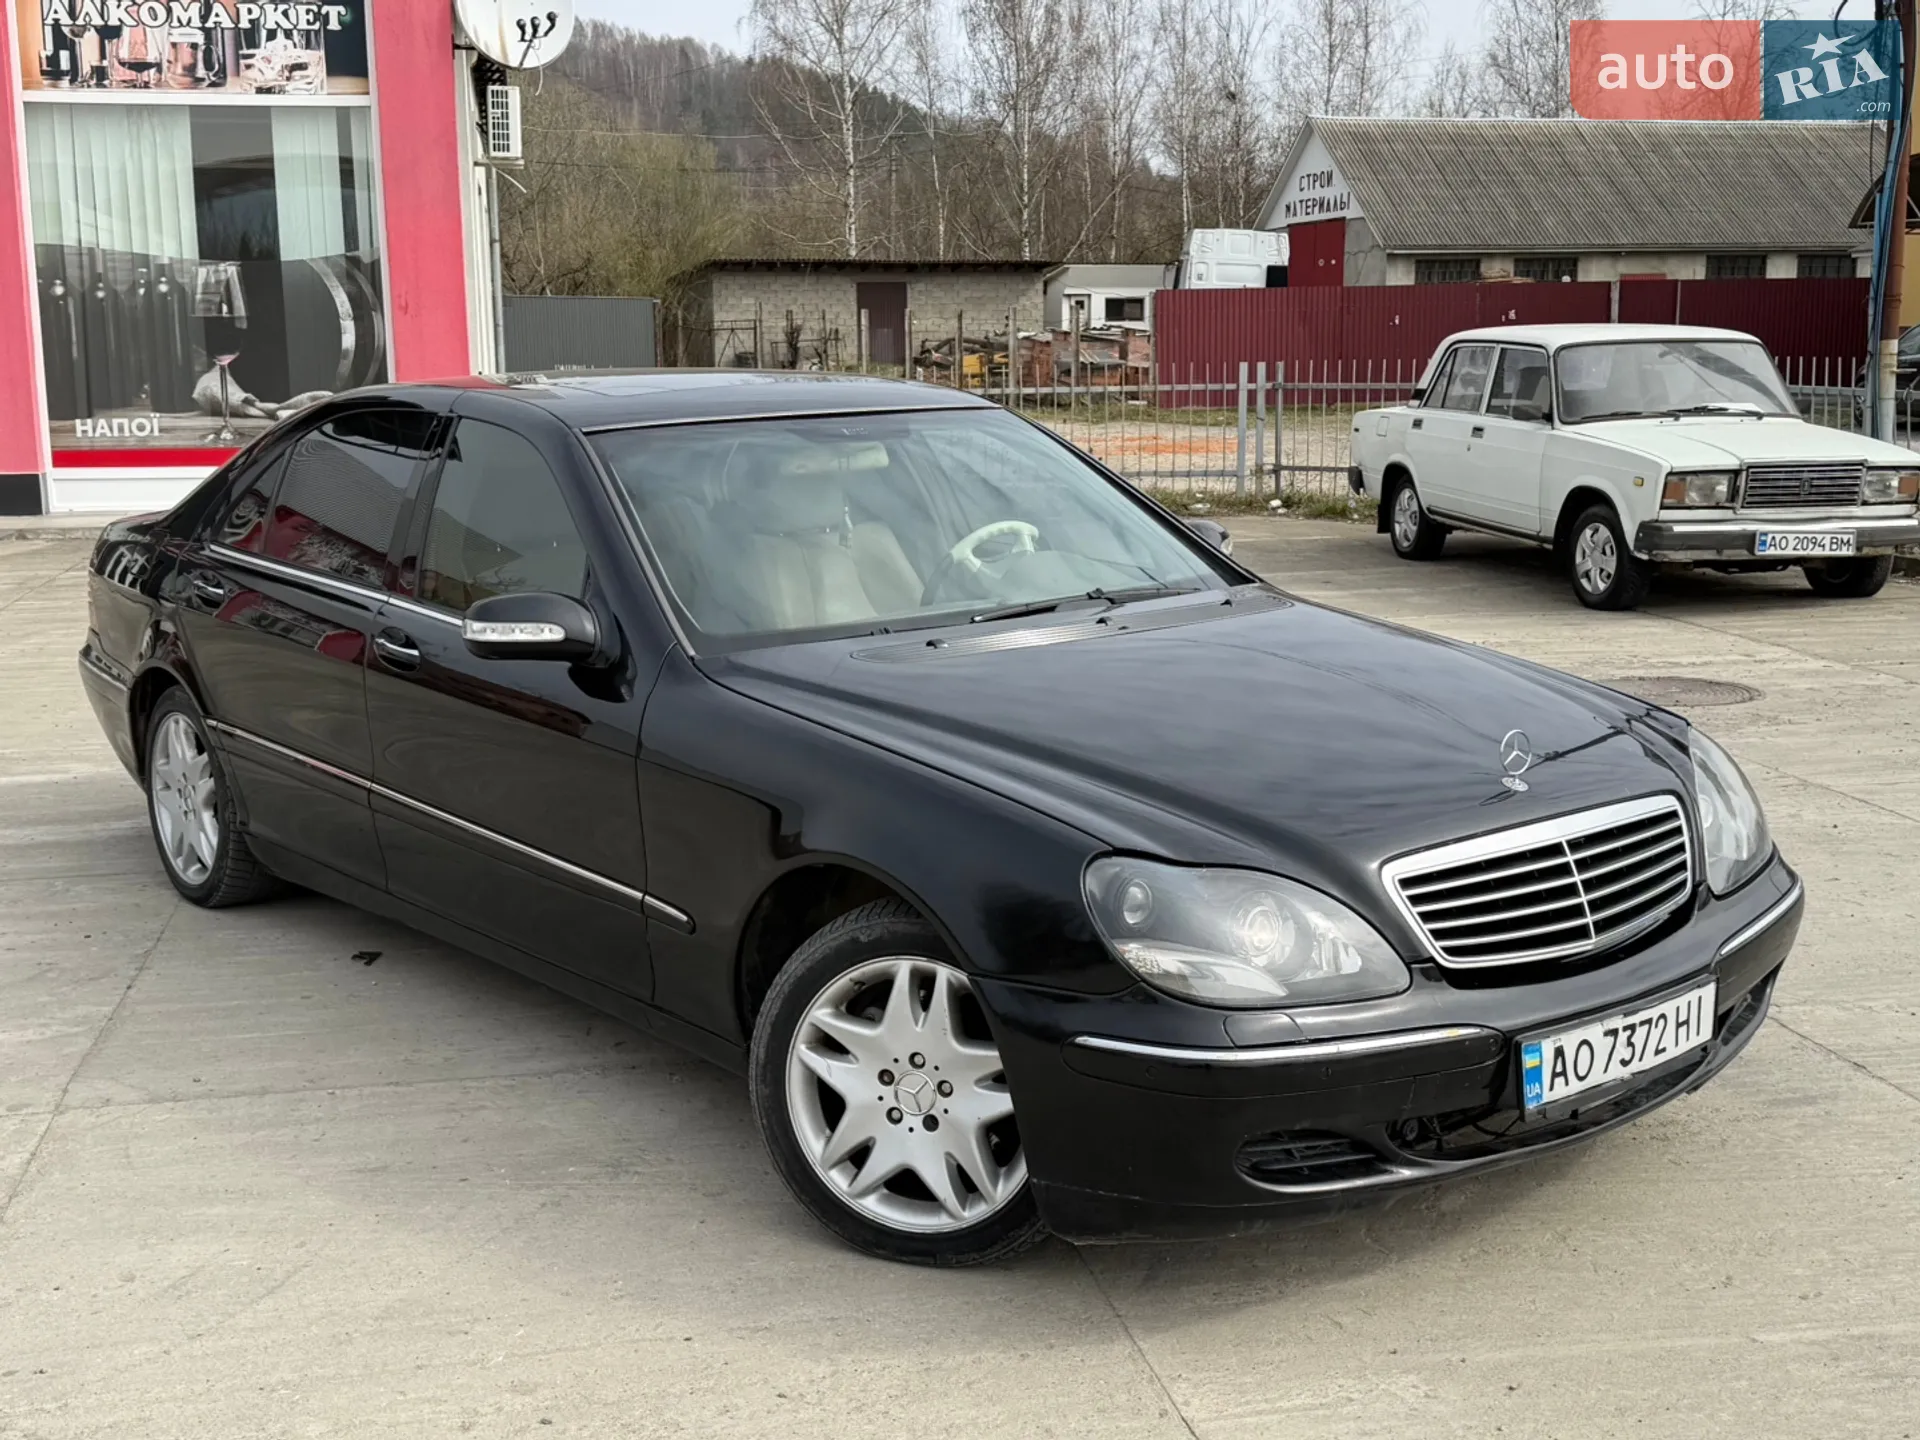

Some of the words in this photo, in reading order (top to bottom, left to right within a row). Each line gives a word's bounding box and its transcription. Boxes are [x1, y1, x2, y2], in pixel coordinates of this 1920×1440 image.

[44, 0, 347, 31] АЛКОМАРКЕТ
[1285, 191, 1351, 219] МАТЕРИАЛЫ
[75, 414, 160, 437] НАПОЇ
[1767, 535, 1789, 551] AO
[1792, 536, 1826, 552] 2094
[1829, 536, 1852, 552] BM
[1549, 1038, 1595, 1093] AO
[1603, 1012, 1668, 1074] 7372
[1675, 995, 1703, 1047] HI
[1526, 1081, 1541, 1098] UA
